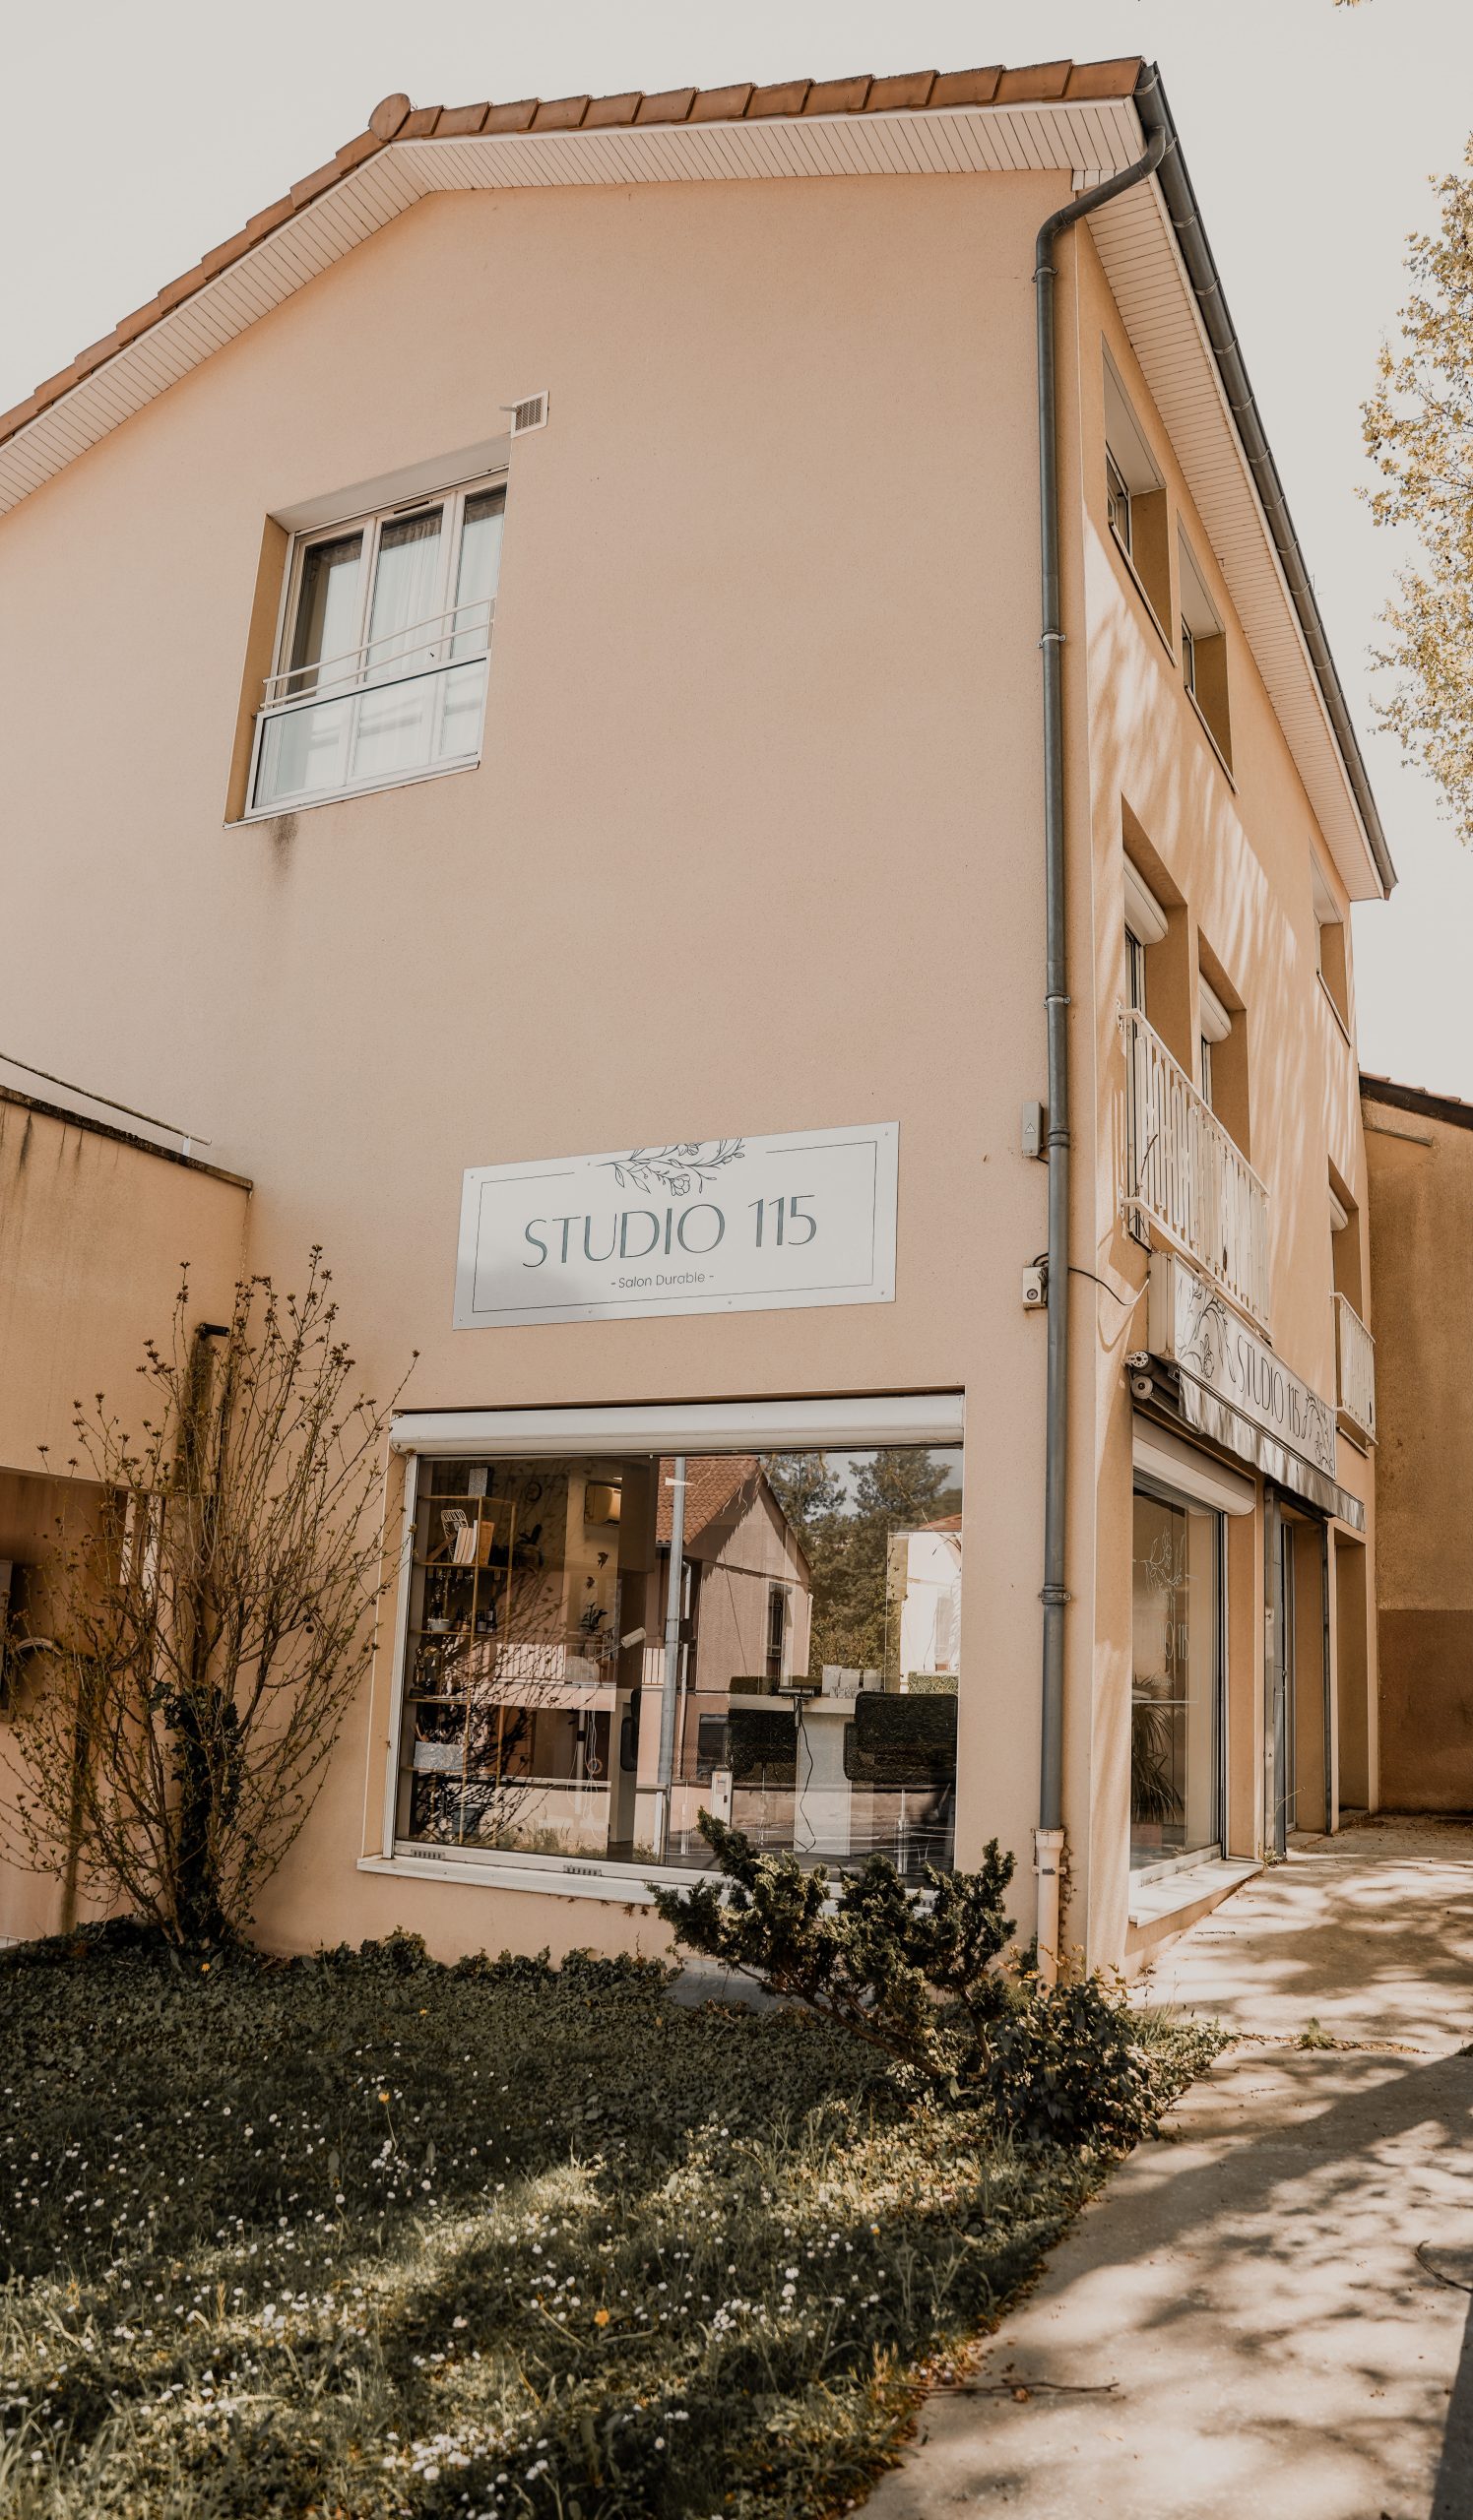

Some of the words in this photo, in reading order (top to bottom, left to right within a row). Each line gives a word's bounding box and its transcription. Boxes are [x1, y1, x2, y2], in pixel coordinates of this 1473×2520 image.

[522, 1204, 726, 1268] STUDIO
[747, 1194, 818, 1248] 115
[656, 1272, 706, 1287] Durable
[1237, 1335, 1284, 1423] STUDIO
[1286, 1382, 1300, 1438] 115
